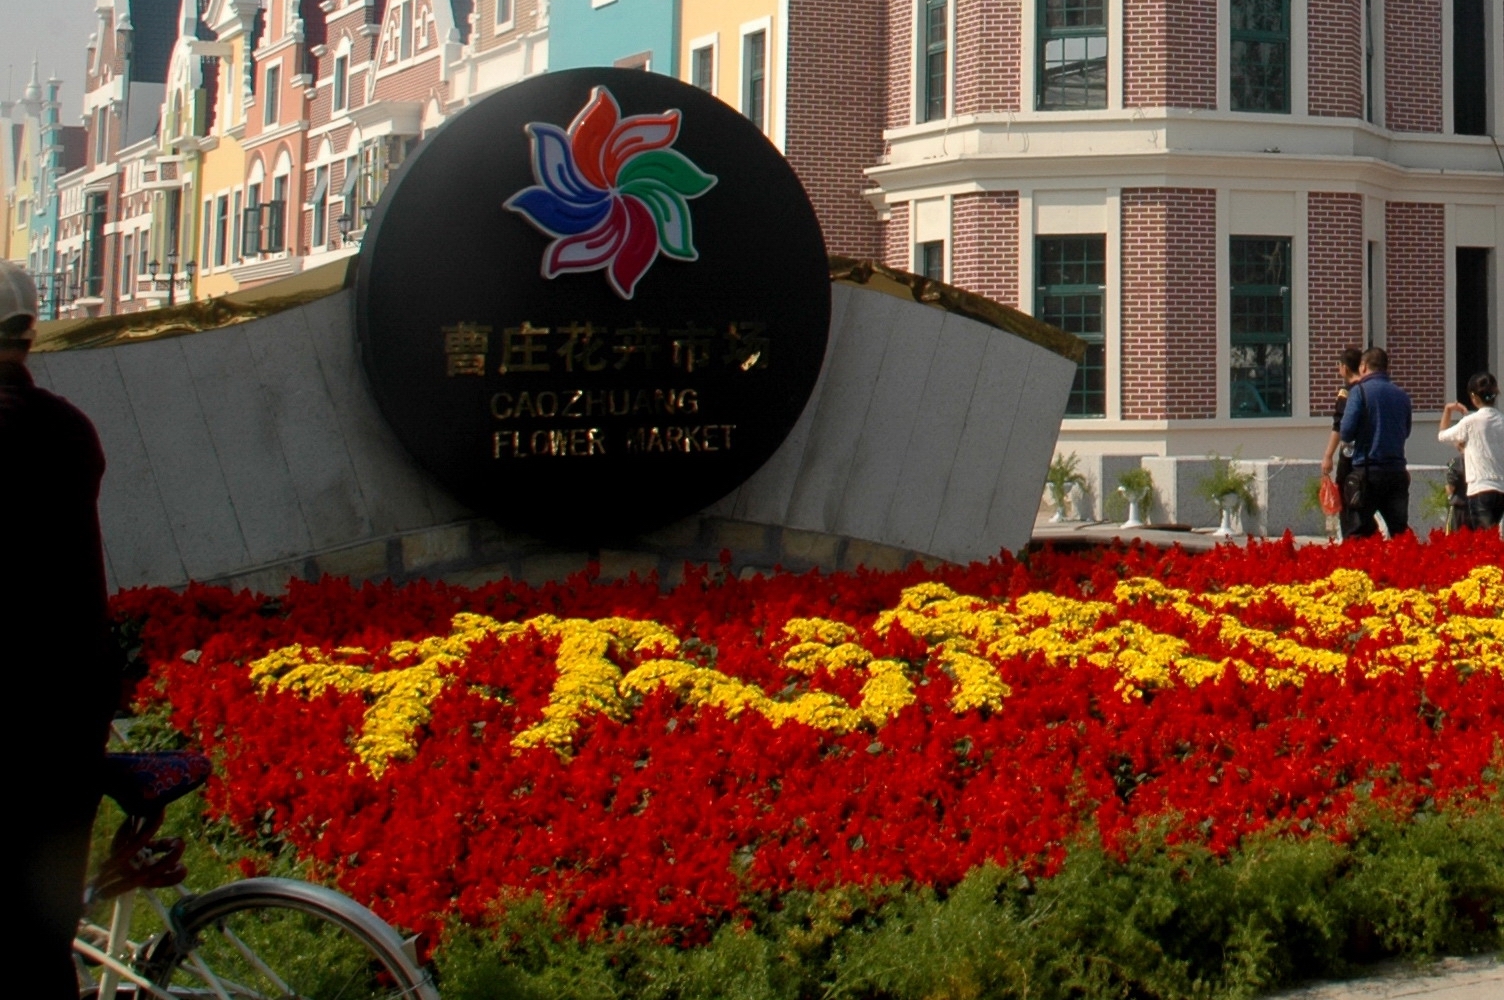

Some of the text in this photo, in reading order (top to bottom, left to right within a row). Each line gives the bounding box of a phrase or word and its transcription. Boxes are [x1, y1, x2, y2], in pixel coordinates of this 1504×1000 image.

[441, 320, 771, 377] 曹庄花卉市场
[490, 387, 699, 420] CAOZHUANG
[492, 424, 738, 459] FLOWER MARKET
